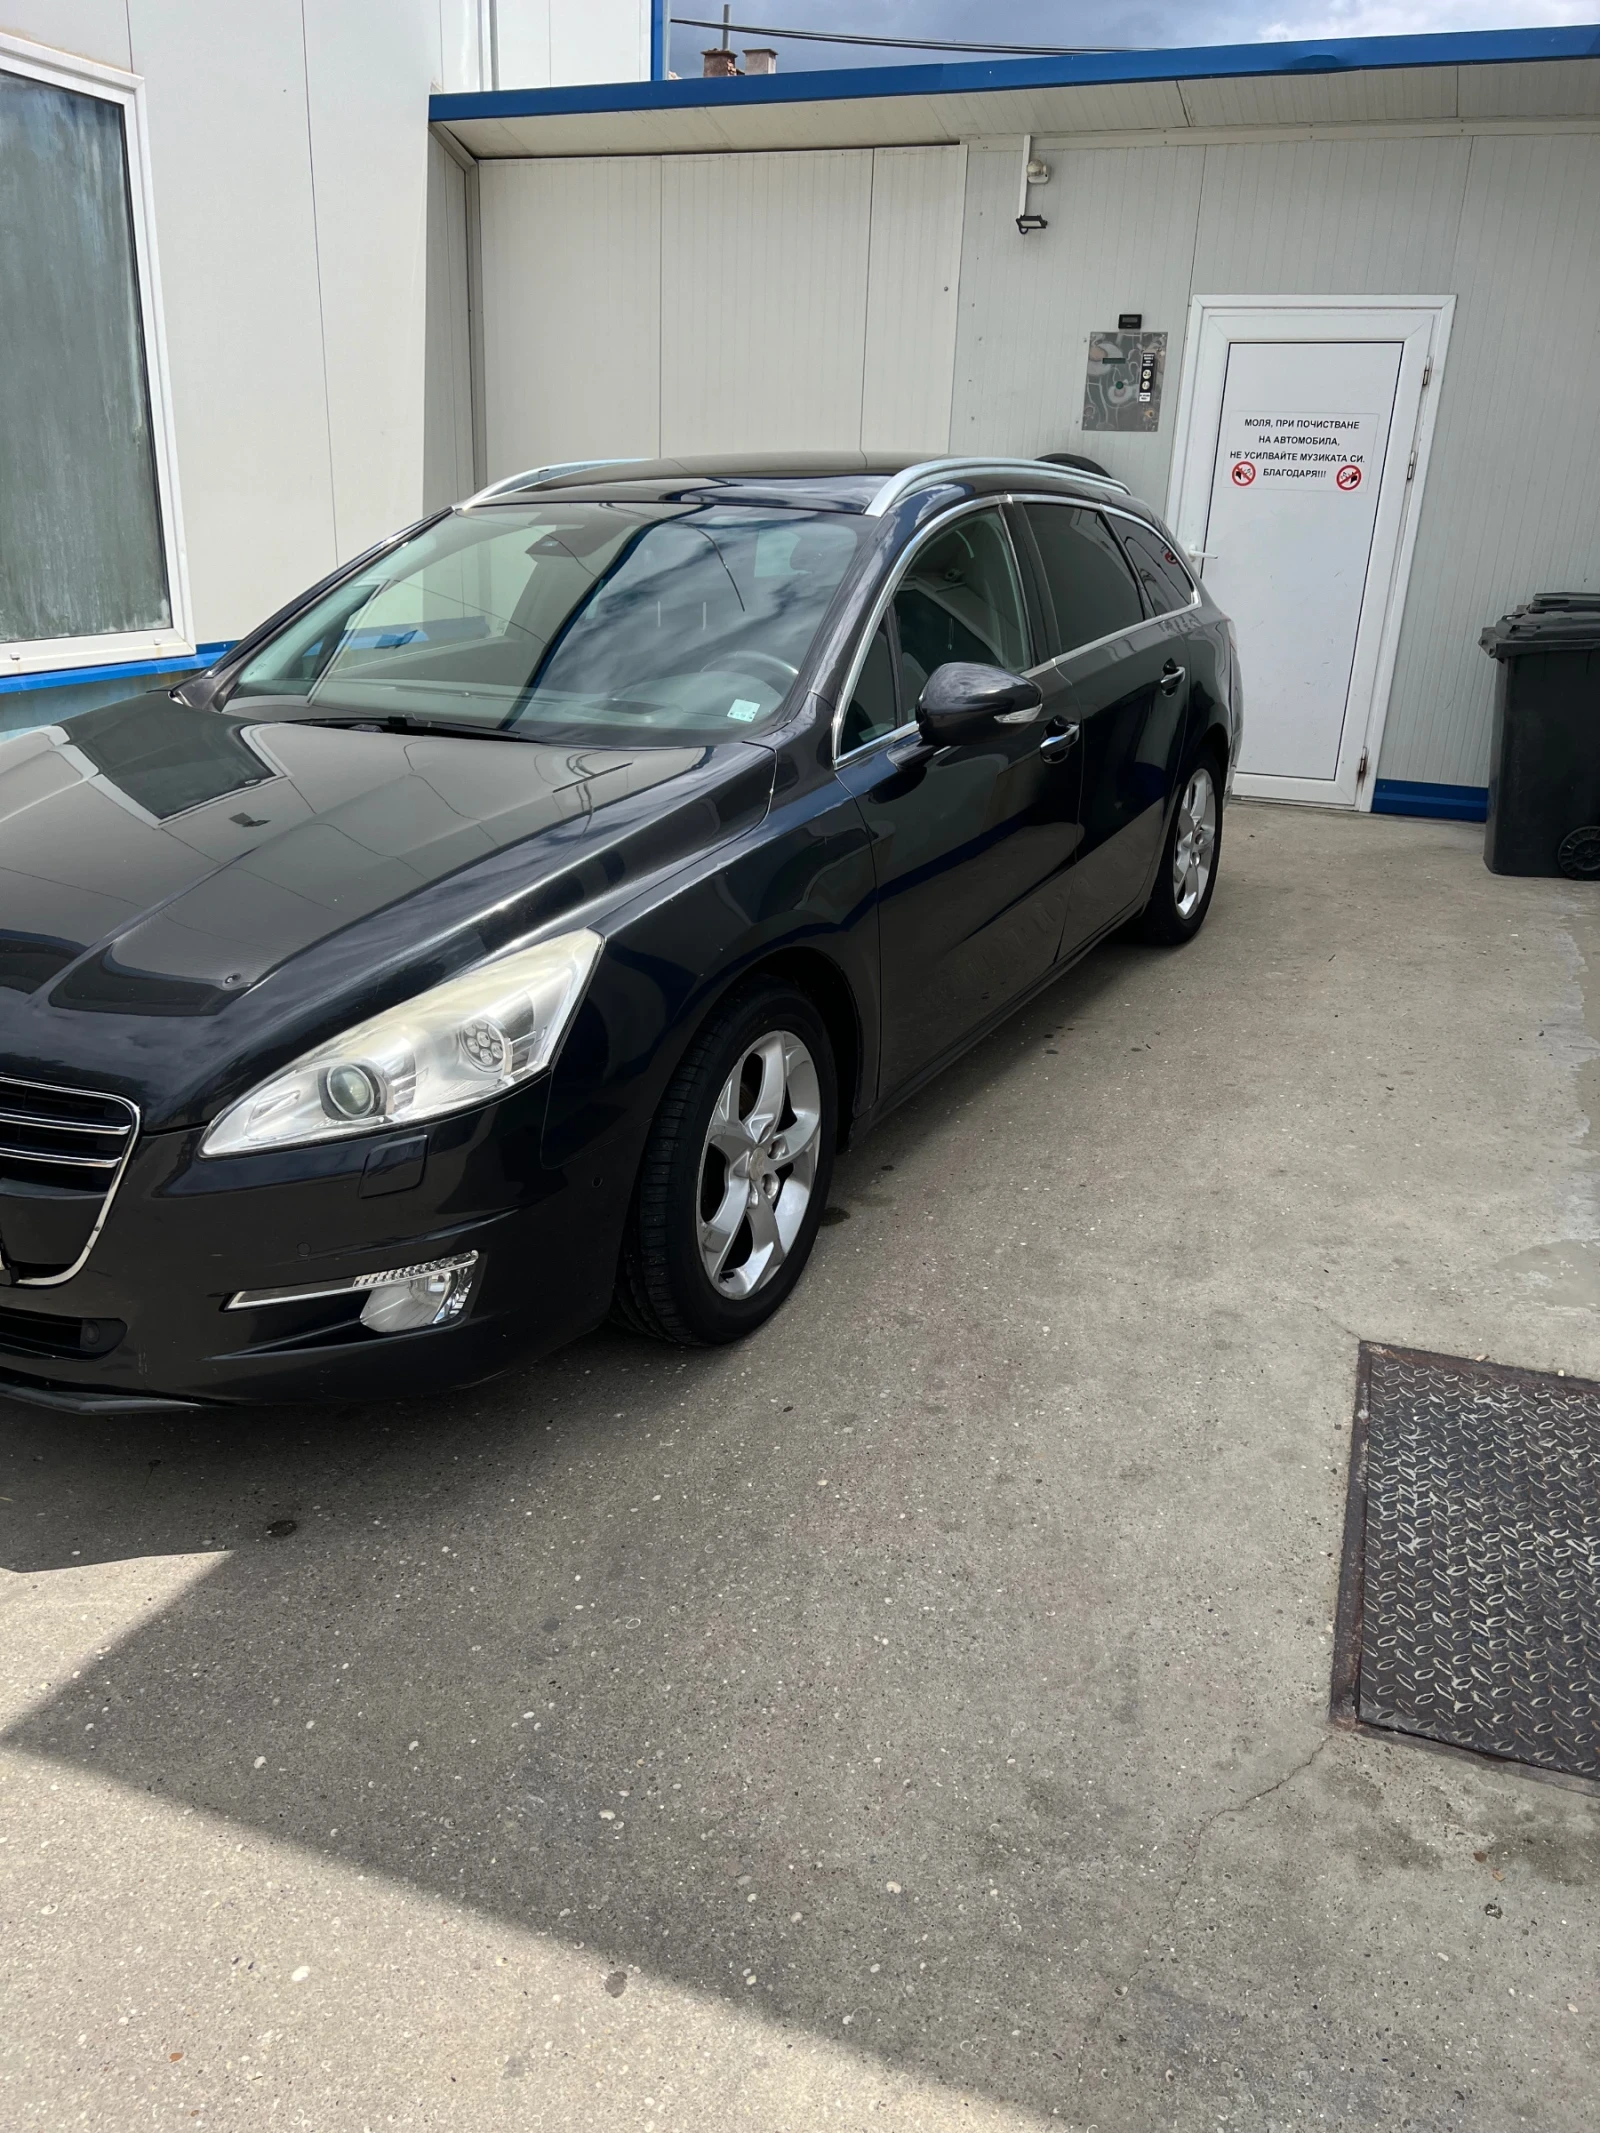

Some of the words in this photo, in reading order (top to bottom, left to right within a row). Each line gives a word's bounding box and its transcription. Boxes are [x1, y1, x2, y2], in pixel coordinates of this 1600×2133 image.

[1245, 418, 1273, 428] МОЛЯ,
[1276, 419, 1294, 428] ПРИ
[1297, 419, 1360, 429] ПОЧИСТВАНЕ
[1258, 436, 1271, 444] НА
[1273, 436, 1340, 446] АВТОМОБИЛА,
[1230, 451, 1242, 459] НЕ
[1244, 451, 1298, 461] УСИЛВАЙТЕ
[1300, 453, 1348, 462] МУЗИКАТА
[1350, 455, 1365, 463] СИ.
[1263, 468, 1326, 478] БЛАГОДАРЯ!!!
